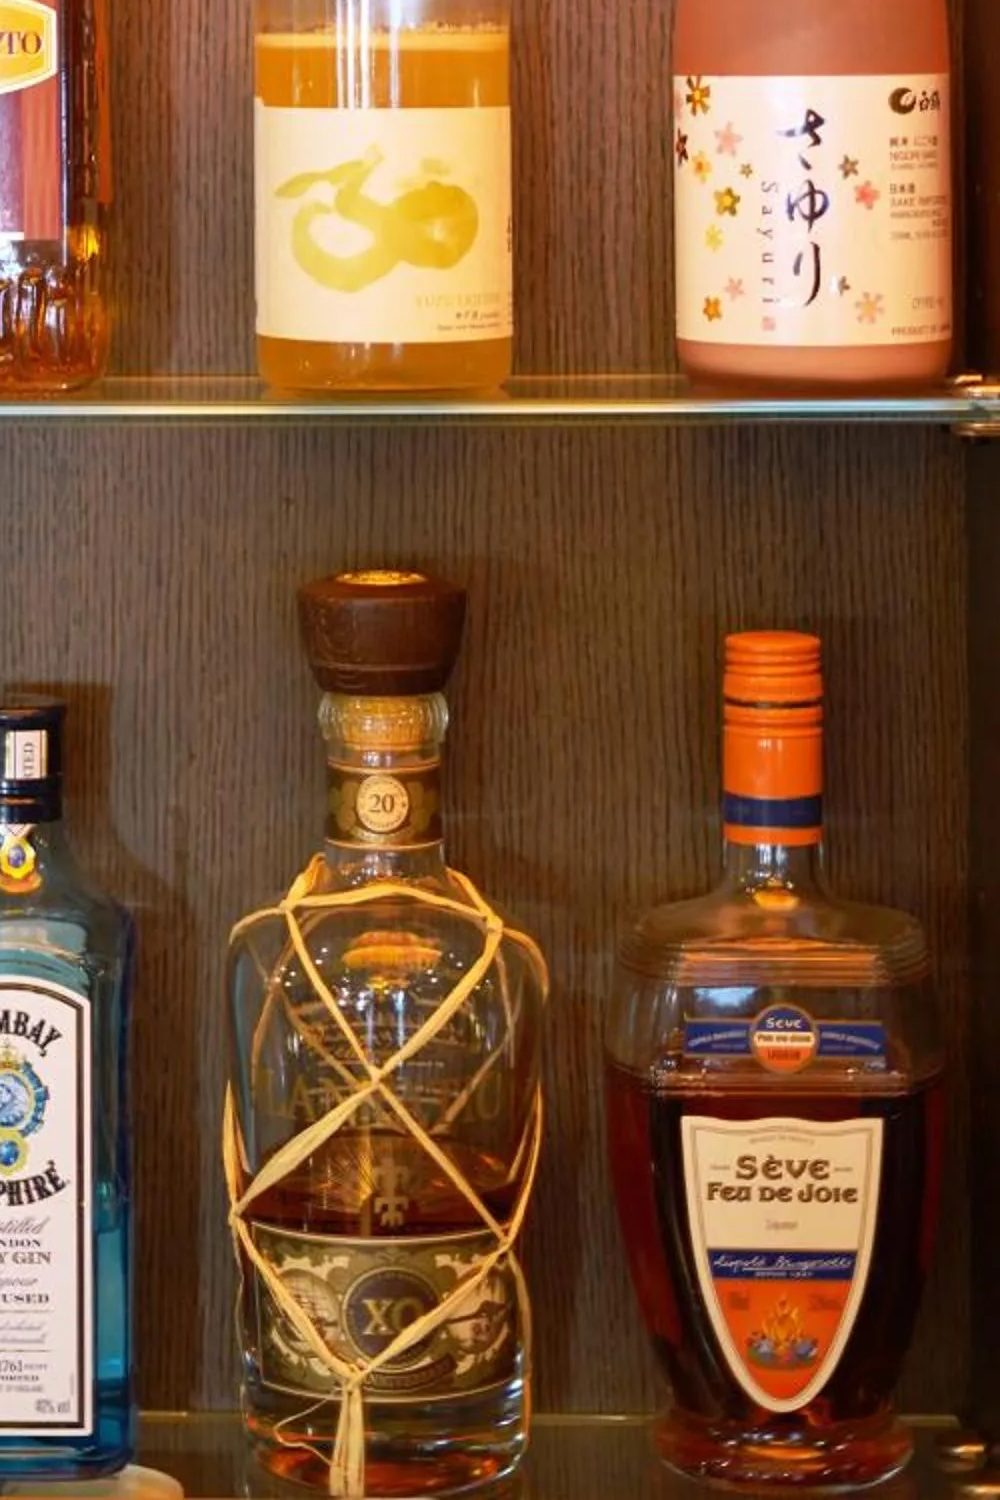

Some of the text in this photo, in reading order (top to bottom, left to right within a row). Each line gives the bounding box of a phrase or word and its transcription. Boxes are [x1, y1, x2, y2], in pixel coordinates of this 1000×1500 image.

[756, 180, 779, 306] Sayuri
[369, 793, 396, 814] 20
[11, 1251, 52, 1265] GIN
